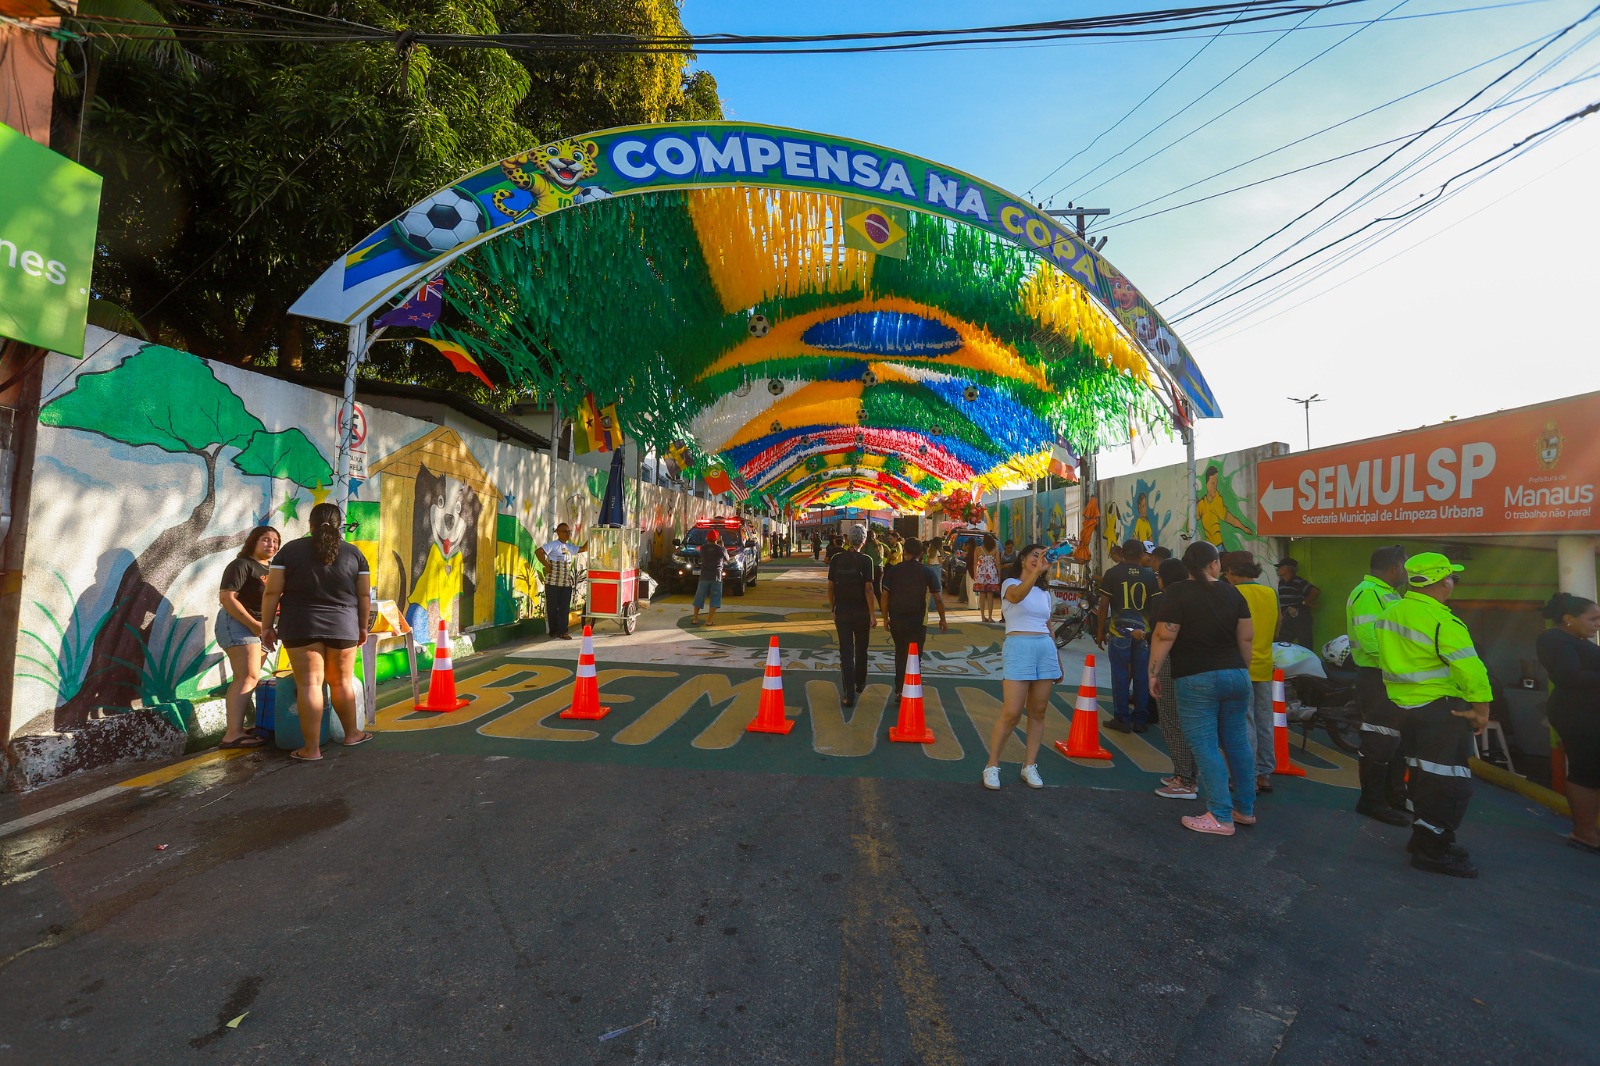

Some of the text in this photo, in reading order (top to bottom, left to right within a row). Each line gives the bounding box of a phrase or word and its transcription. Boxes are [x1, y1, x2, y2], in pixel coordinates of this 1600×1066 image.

[612, 136, 1097, 286] COMPENSA NA COPA
[1297, 441, 1497, 511] SEMULSP
[1528, 473, 1567, 484] Prefeitura de
[1503, 484, 1594, 508] Manaus
[1302, 505, 1484, 525] Secretaria Municipal de Limpeza Urbana
[1504, 507, 1591, 520] O trabalho não para!
[1120, 581, 1147, 611] 10
